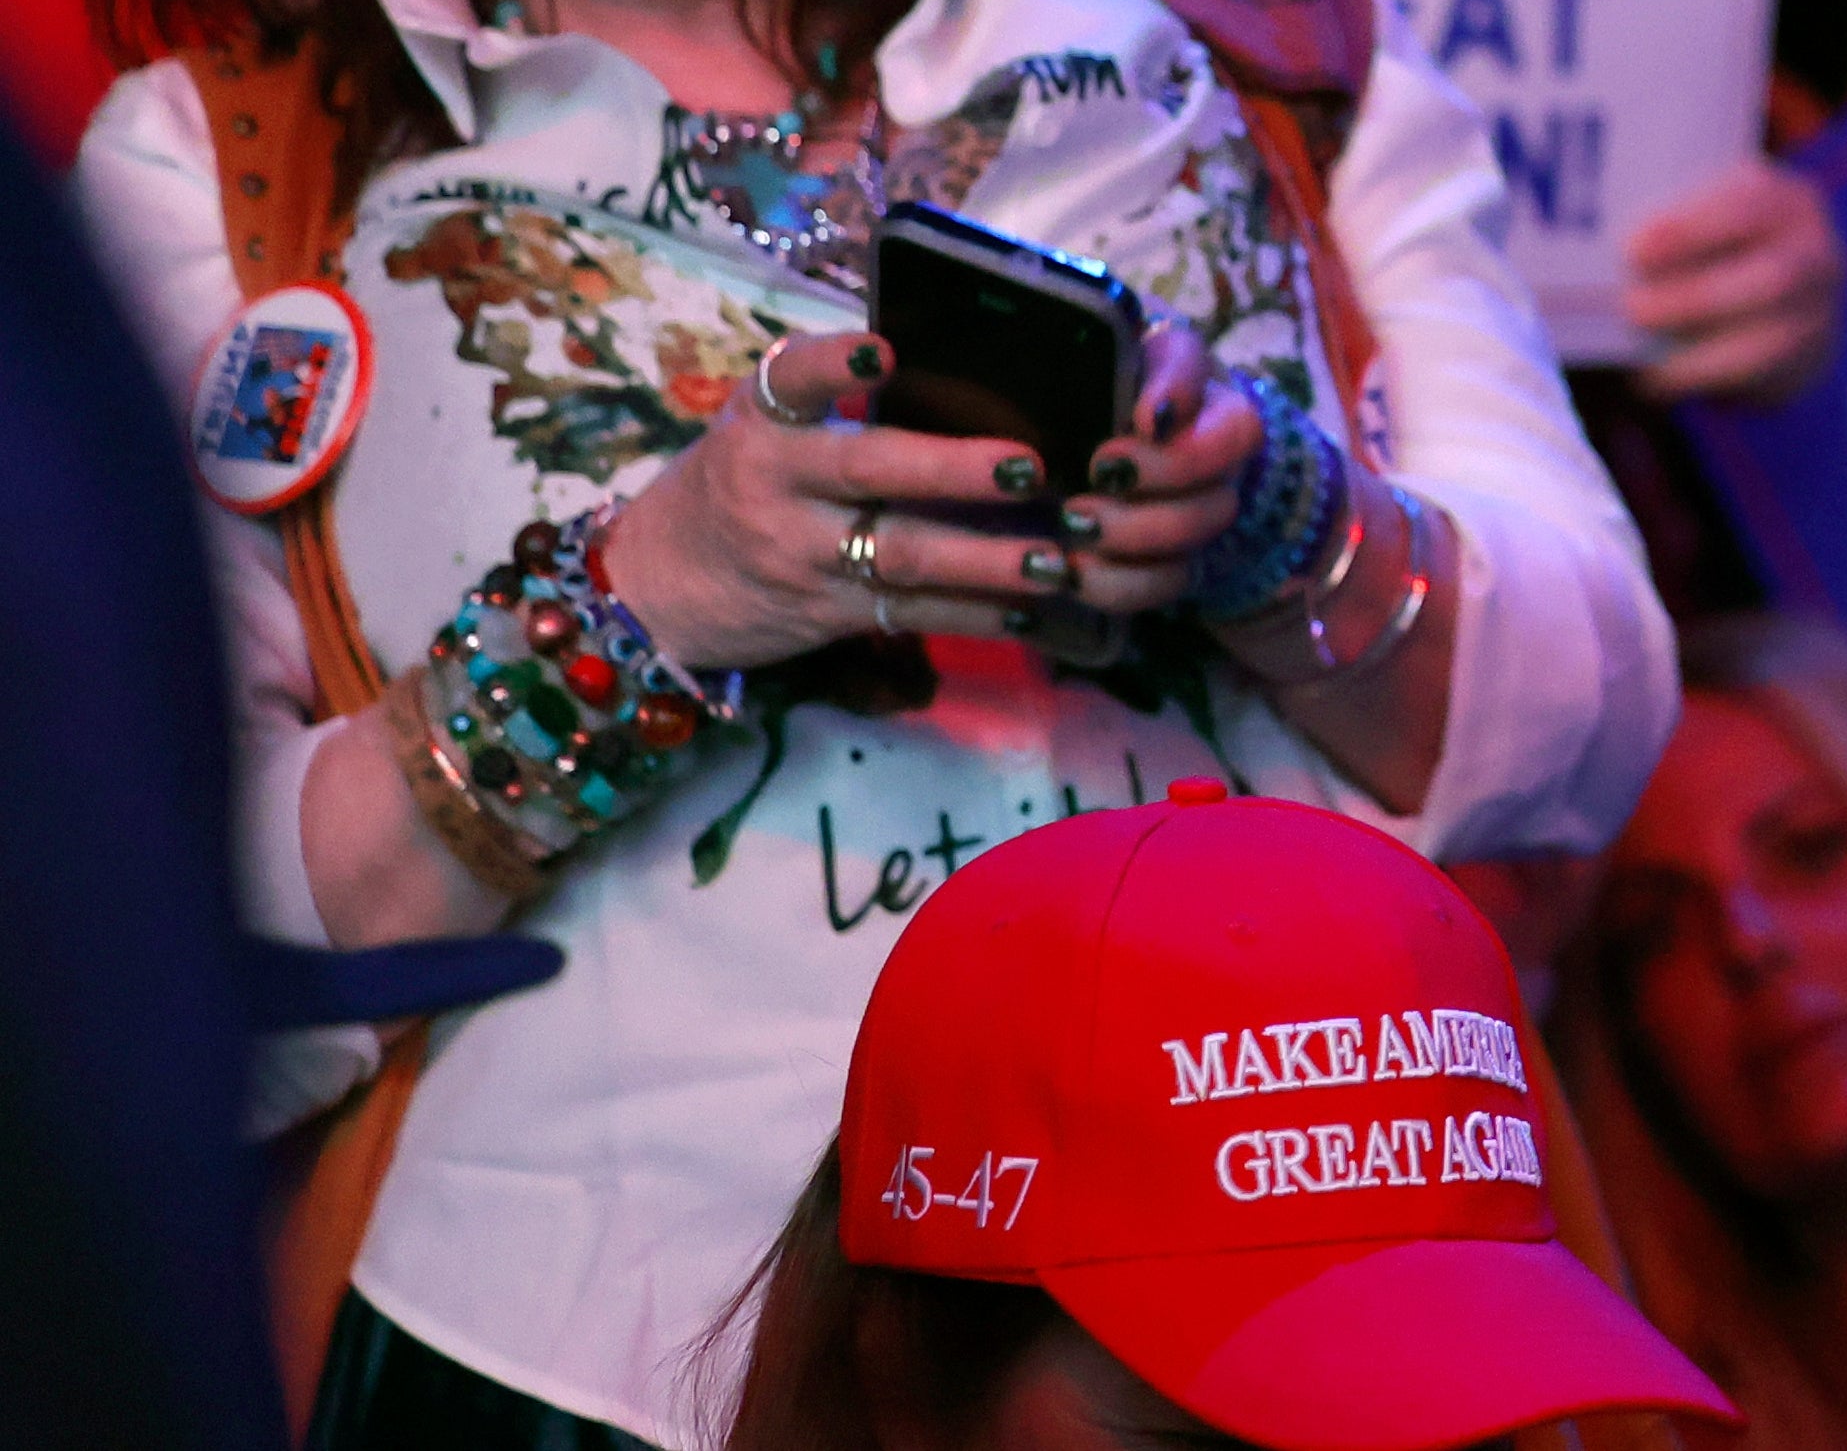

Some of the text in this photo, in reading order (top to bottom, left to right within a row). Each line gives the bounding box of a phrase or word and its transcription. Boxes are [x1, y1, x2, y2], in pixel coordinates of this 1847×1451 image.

[1161, 1016, 1368, 1106] MAKE
[881, 1143, 1040, 1232] 45-47
[1213, 1118, 1434, 1203] GREAT
